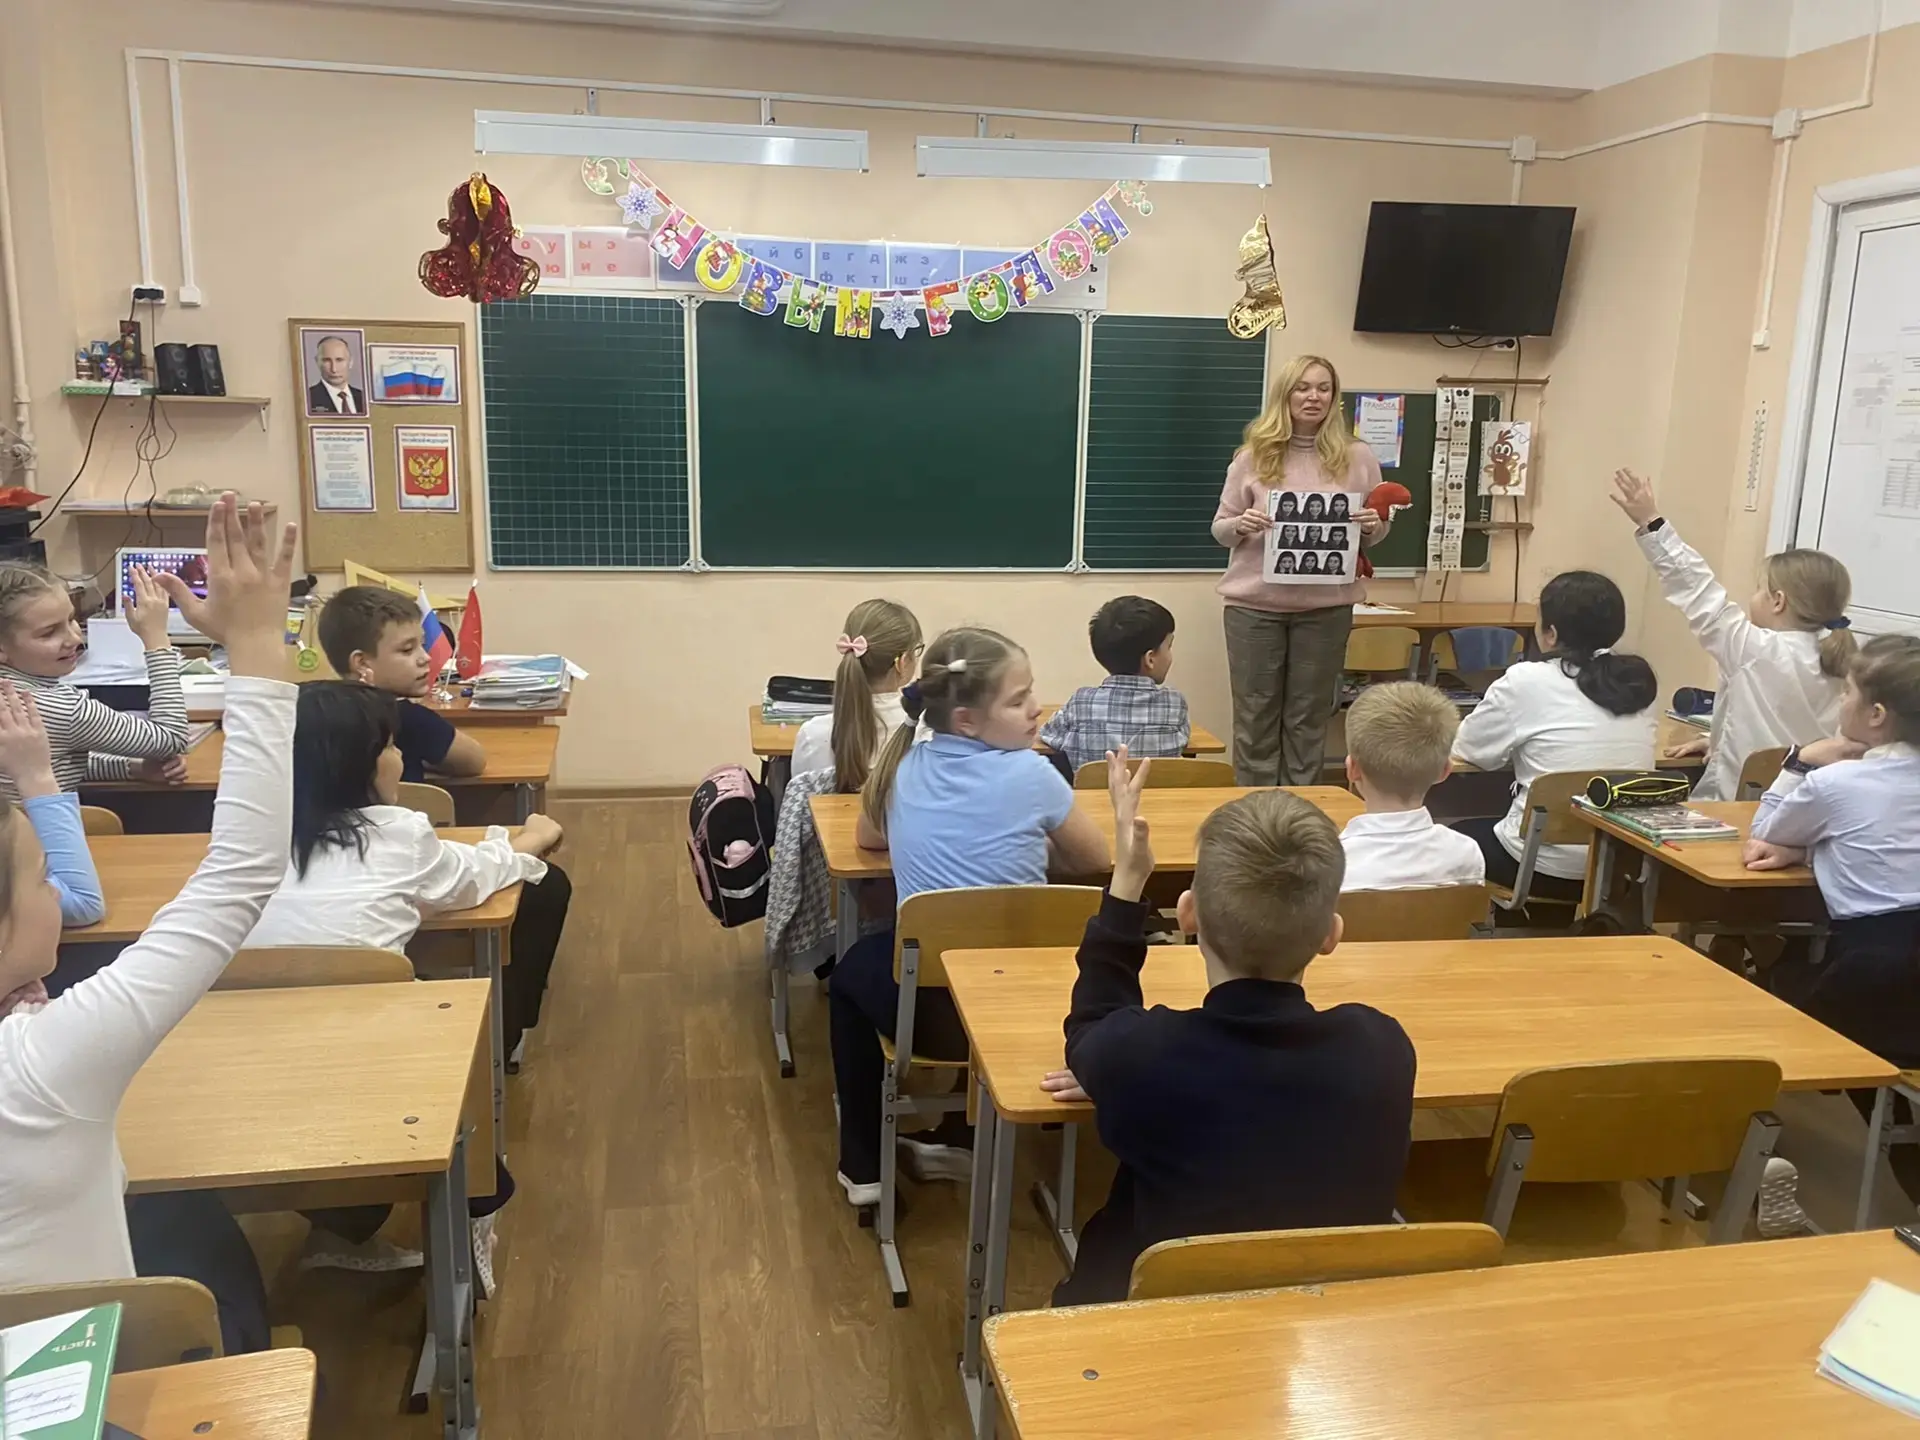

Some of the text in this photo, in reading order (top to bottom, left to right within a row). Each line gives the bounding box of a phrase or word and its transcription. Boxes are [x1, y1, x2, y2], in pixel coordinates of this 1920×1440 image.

[548, 242, 556, 254] у
[579, 240, 591, 250] ы
[606, 241, 616, 250] э
[769, 246, 779, 258] й
[794, 248, 804, 260] б
[822, 252, 830, 260] в
[848, 252, 855, 260] г
[870, 254, 880, 264] д
[895, 255, 908, 264] ж
[920, 256, 930, 265] з
[546, 262, 616, 273] ю и е
[820, 270, 833, 283] ф
[846, 274, 856, 282] к
[894, 276, 907, 284] ш
[920, 277, 929, 286] с
